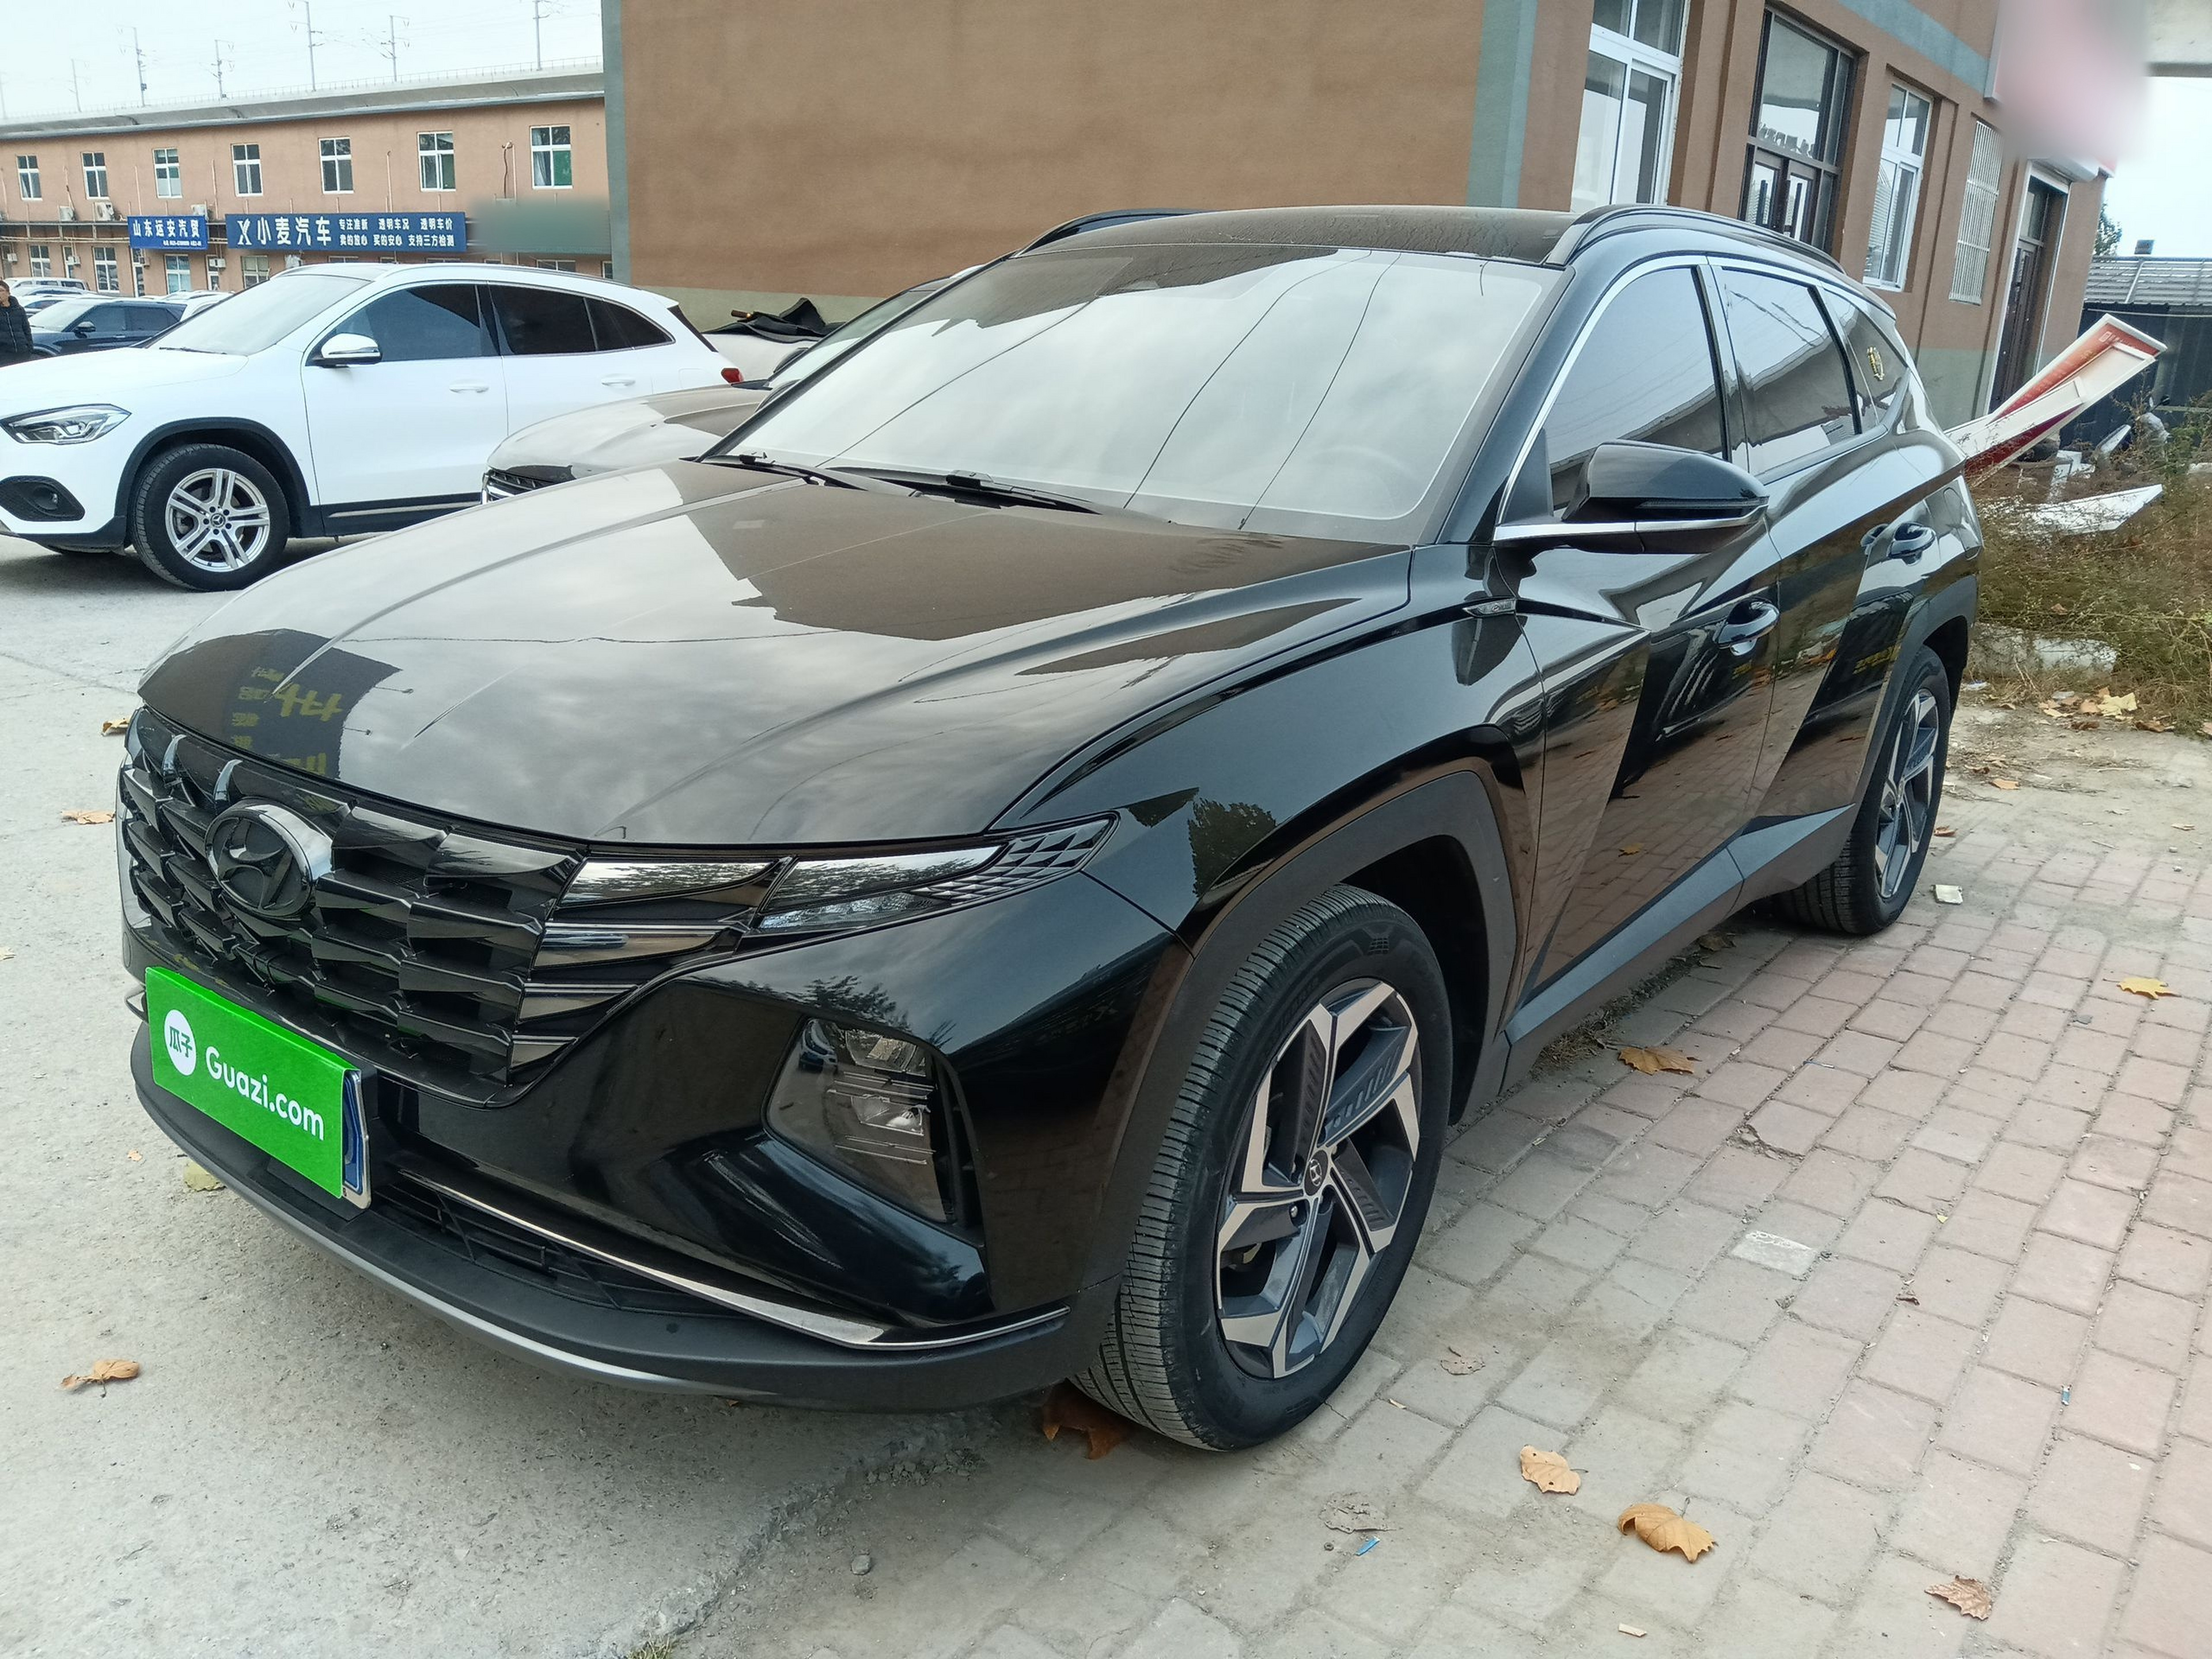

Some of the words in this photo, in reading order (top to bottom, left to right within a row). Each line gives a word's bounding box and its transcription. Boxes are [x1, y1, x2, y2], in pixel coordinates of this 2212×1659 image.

[133, 219, 200, 238] 山东运安汽贸
[257, 216, 332, 246] 小麦汽车
[339, 218, 368, 230] 专注准新
[378, 218, 410, 230] 透明车况
[420, 218, 453, 230] 透明车价
[408, 234, 454, 247] 支持三方检测
[169, 1026, 193, 1058] 瓜子
[205, 1046, 324, 1141] Guazi.com
